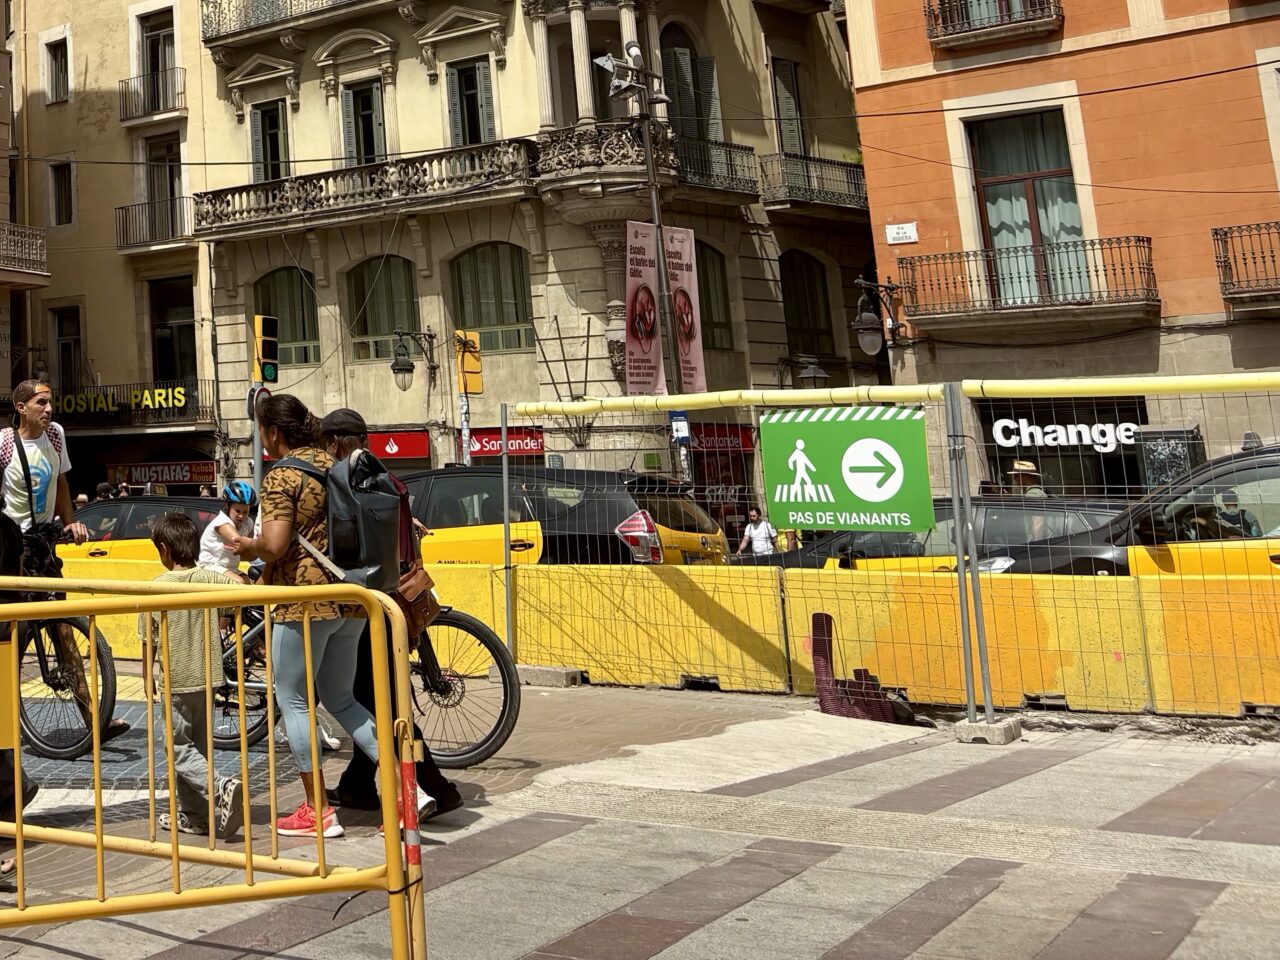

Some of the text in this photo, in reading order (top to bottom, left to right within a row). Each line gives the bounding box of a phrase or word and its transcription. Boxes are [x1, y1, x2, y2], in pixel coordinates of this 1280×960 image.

[53, 387, 186, 414] HOSTAL PARIS
[482, 436, 544, 452] Sanander
[699, 434, 742, 448] Santander
[992, 418, 1139, 453] Change
[131, 464, 191, 482] MUSTAFA'S
[789, 511, 911, 526] PAS DE VIANANTS
